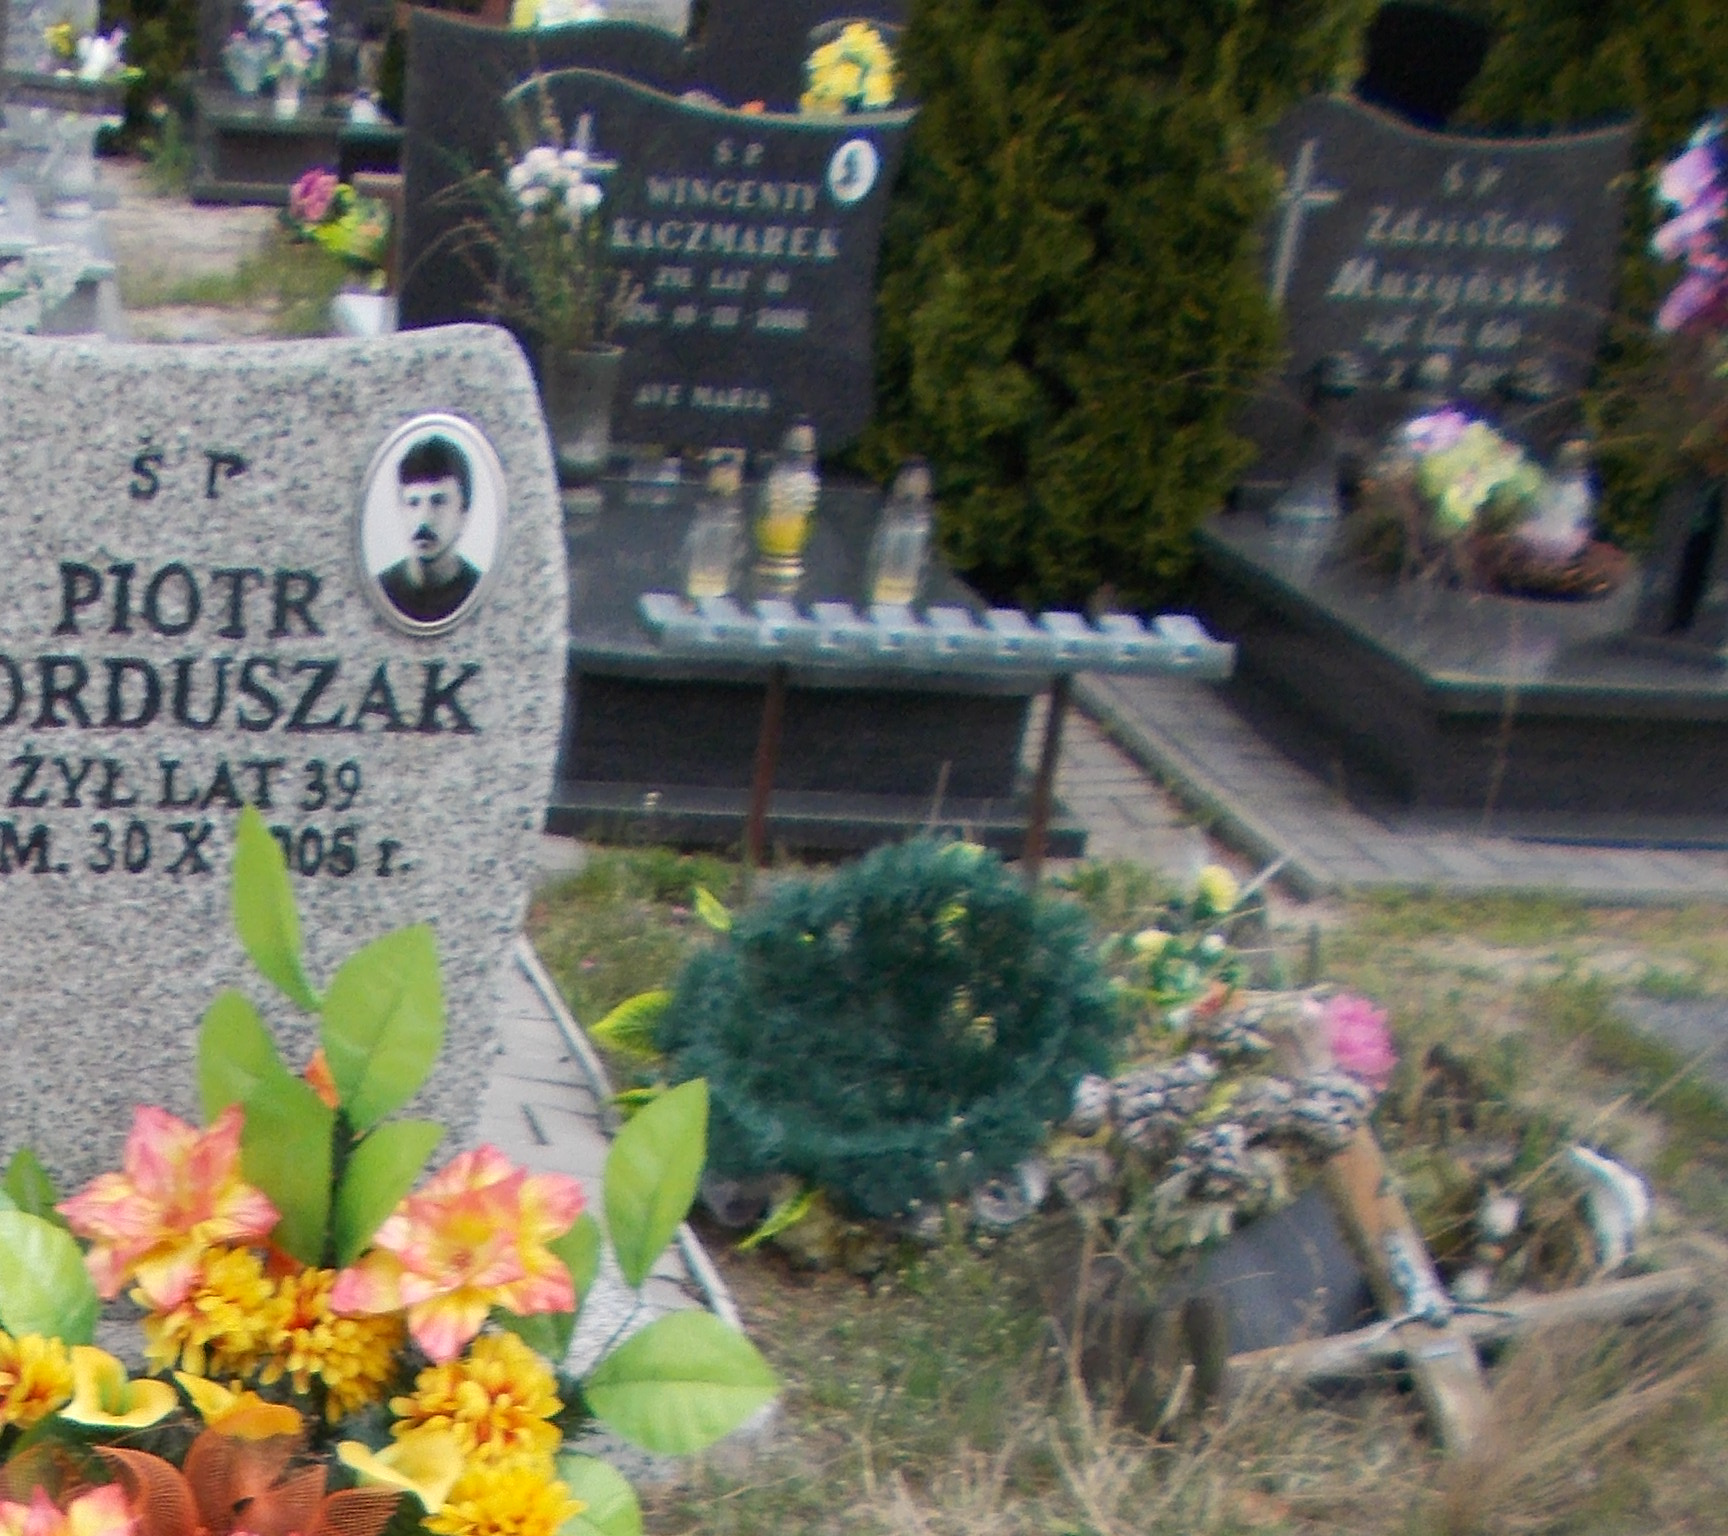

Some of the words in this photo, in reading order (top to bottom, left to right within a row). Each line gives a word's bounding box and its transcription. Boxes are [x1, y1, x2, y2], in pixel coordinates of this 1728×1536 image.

[646, 175, 822, 212] WINCENTY
[611, 217, 842, 258] KACZMAREK
[204, 448, 248, 499] P
[53, 558, 325, 638] PIOTR
[7, 742, 138, 809] ŻYŁ
[158, 758, 288, 810] LAT
[301, 757, 363, 812] 39
[88, 819, 152, 874] 30
[164, 820, 215, 876] X
[376, 837, 416, 878] r.
